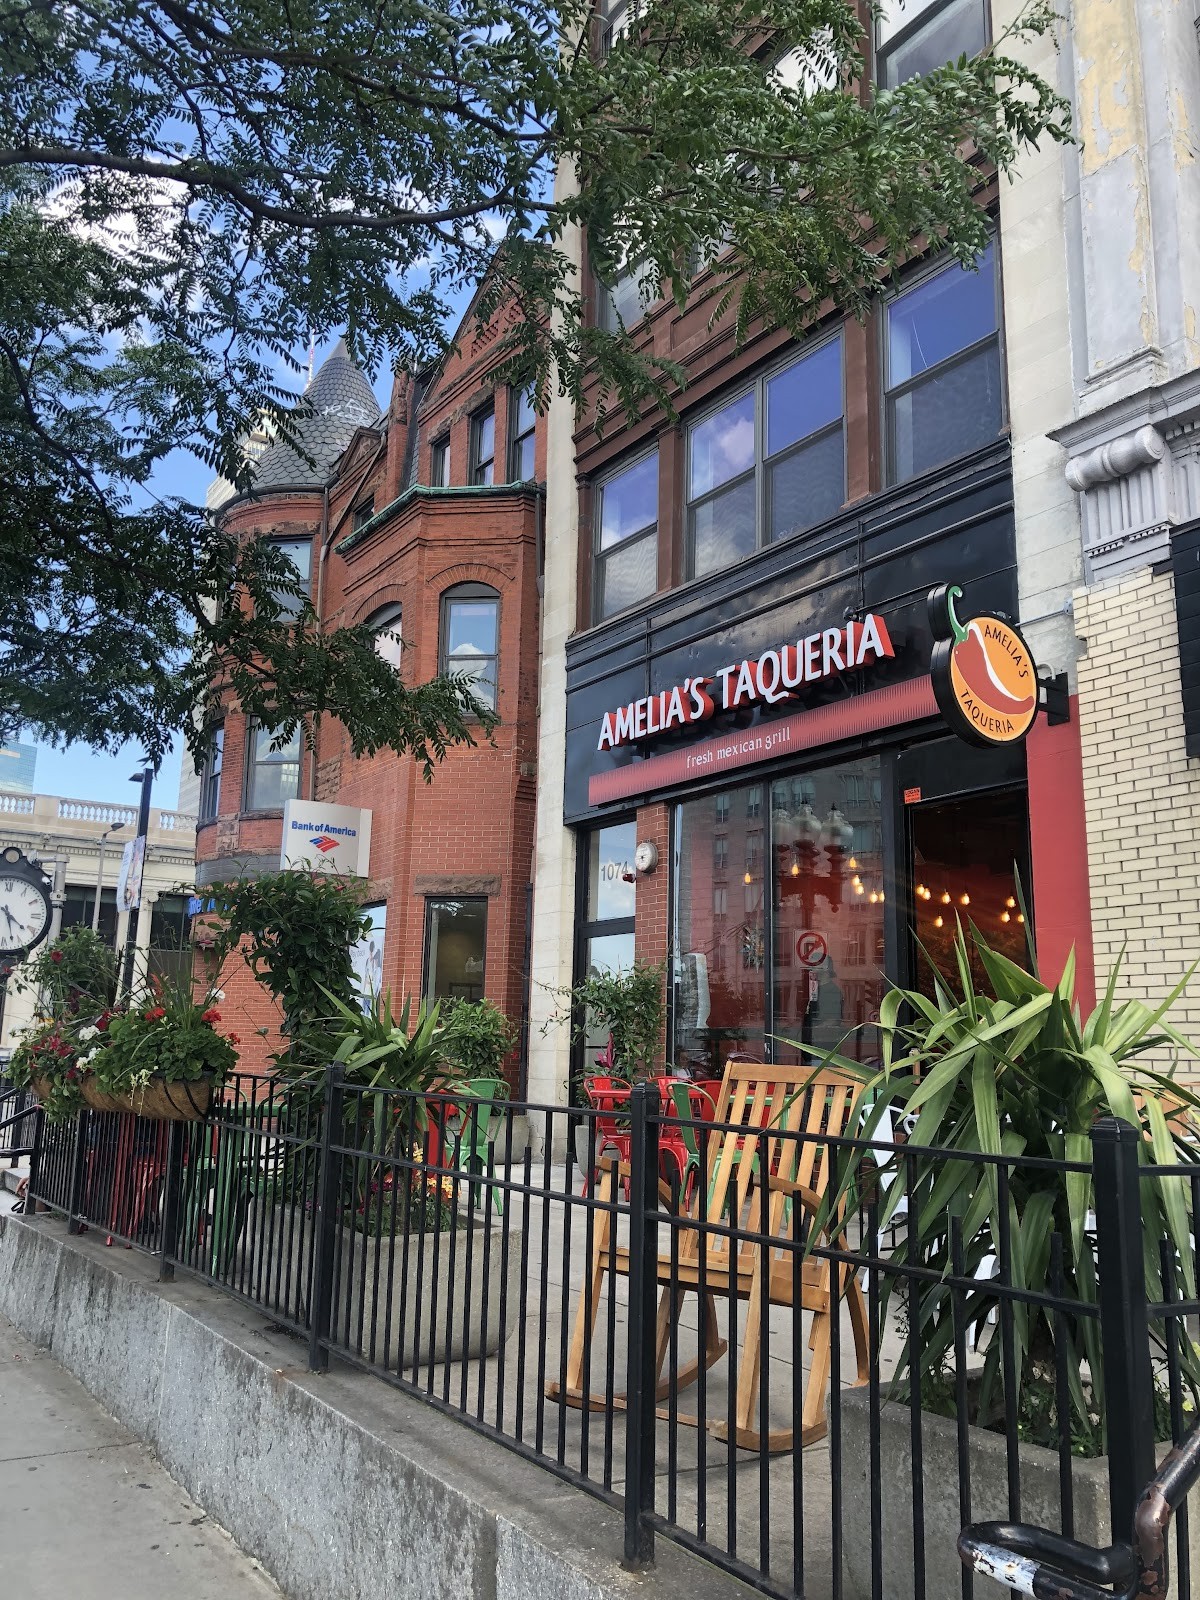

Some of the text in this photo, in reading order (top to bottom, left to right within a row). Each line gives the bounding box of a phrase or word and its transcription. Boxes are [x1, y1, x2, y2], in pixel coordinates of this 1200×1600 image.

[984, 624, 1029, 678] AMELIA'S
[597, 613, 886, 751] AMELIA'S TAQUERIA
[960, 688, 1015, 734] TAQUERIA
[686, 726, 791, 769] fresh mexican grill
[291, 820, 357, 837] Bank of America
[600, 860, 629, 882] 1074
